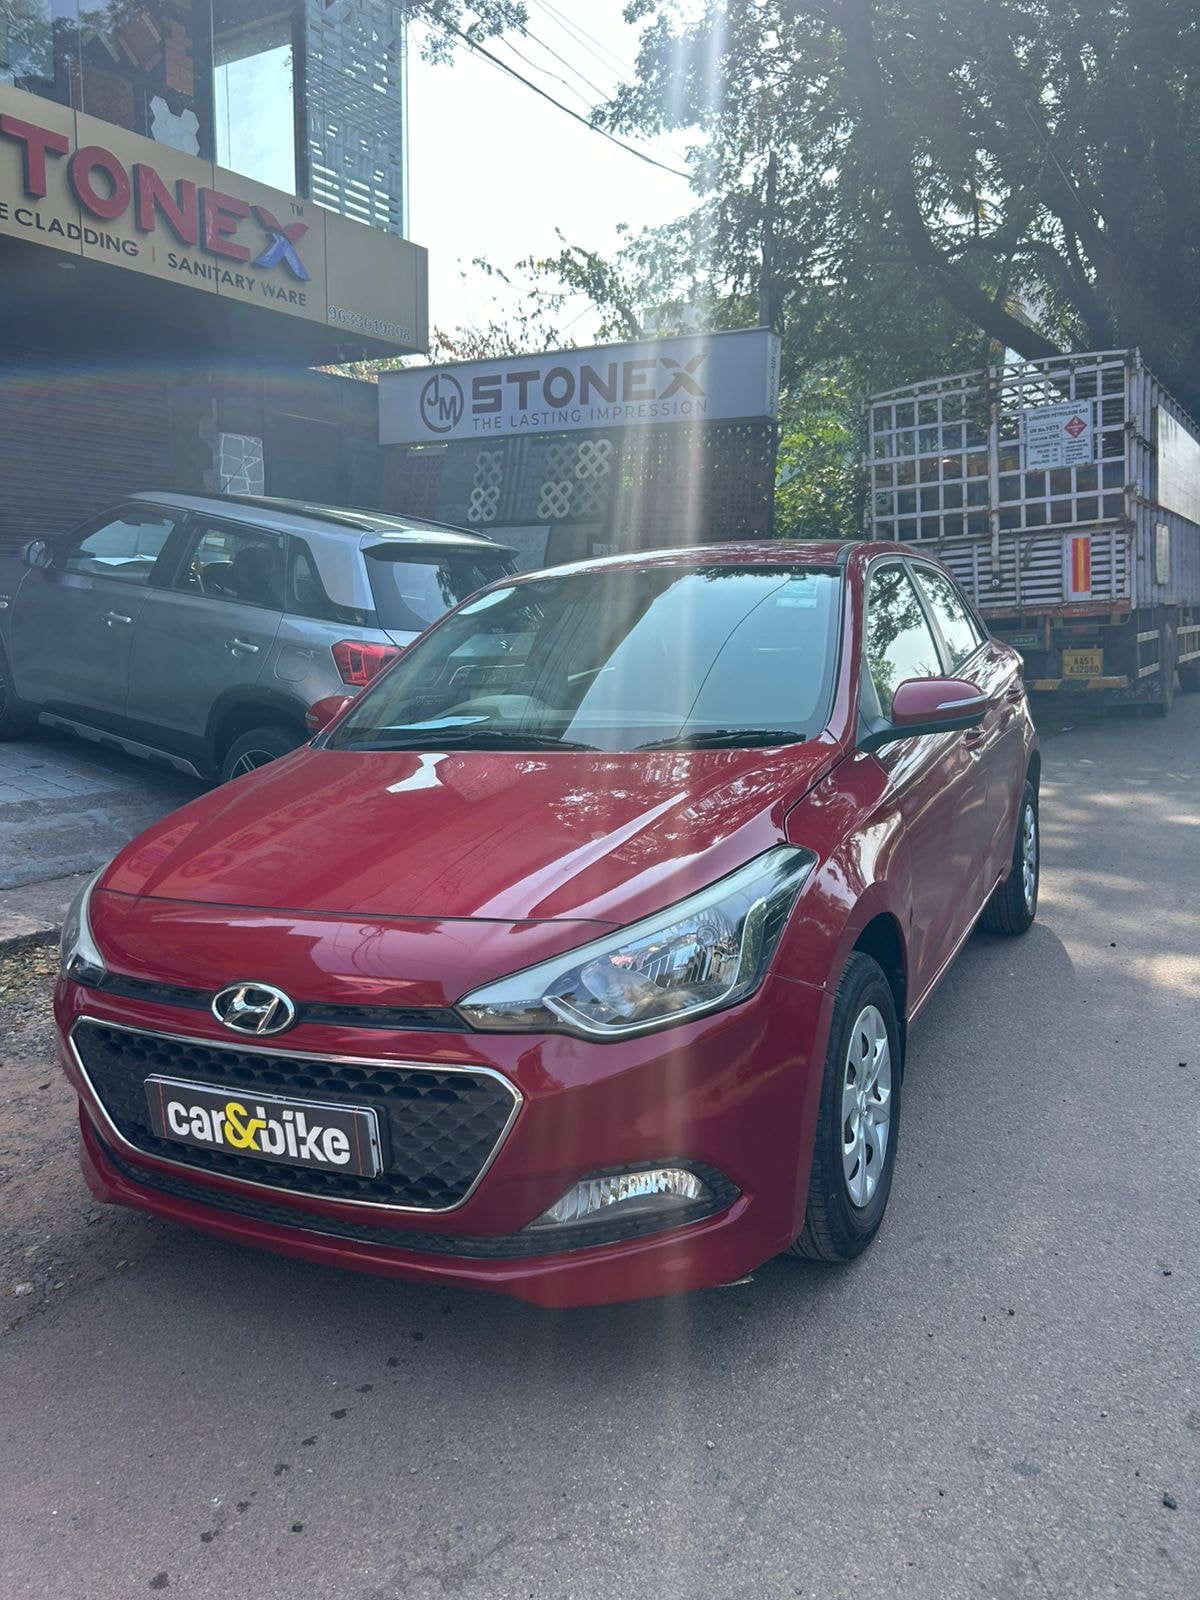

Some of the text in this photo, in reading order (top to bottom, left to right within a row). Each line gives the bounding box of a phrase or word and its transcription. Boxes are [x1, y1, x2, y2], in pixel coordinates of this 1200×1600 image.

[290, 202, 304, 217] TM
[14, 208, 139, 257] CLADDING
[168, 253, 256, 291] SANITARY
[261, 282, 307, 307] WARE
[472, 354, 708, 414] STONEX
[472, 400, 707, 431] THE LASTING IMPRESSION
[167, 1101, 350, 1165] car&bike
